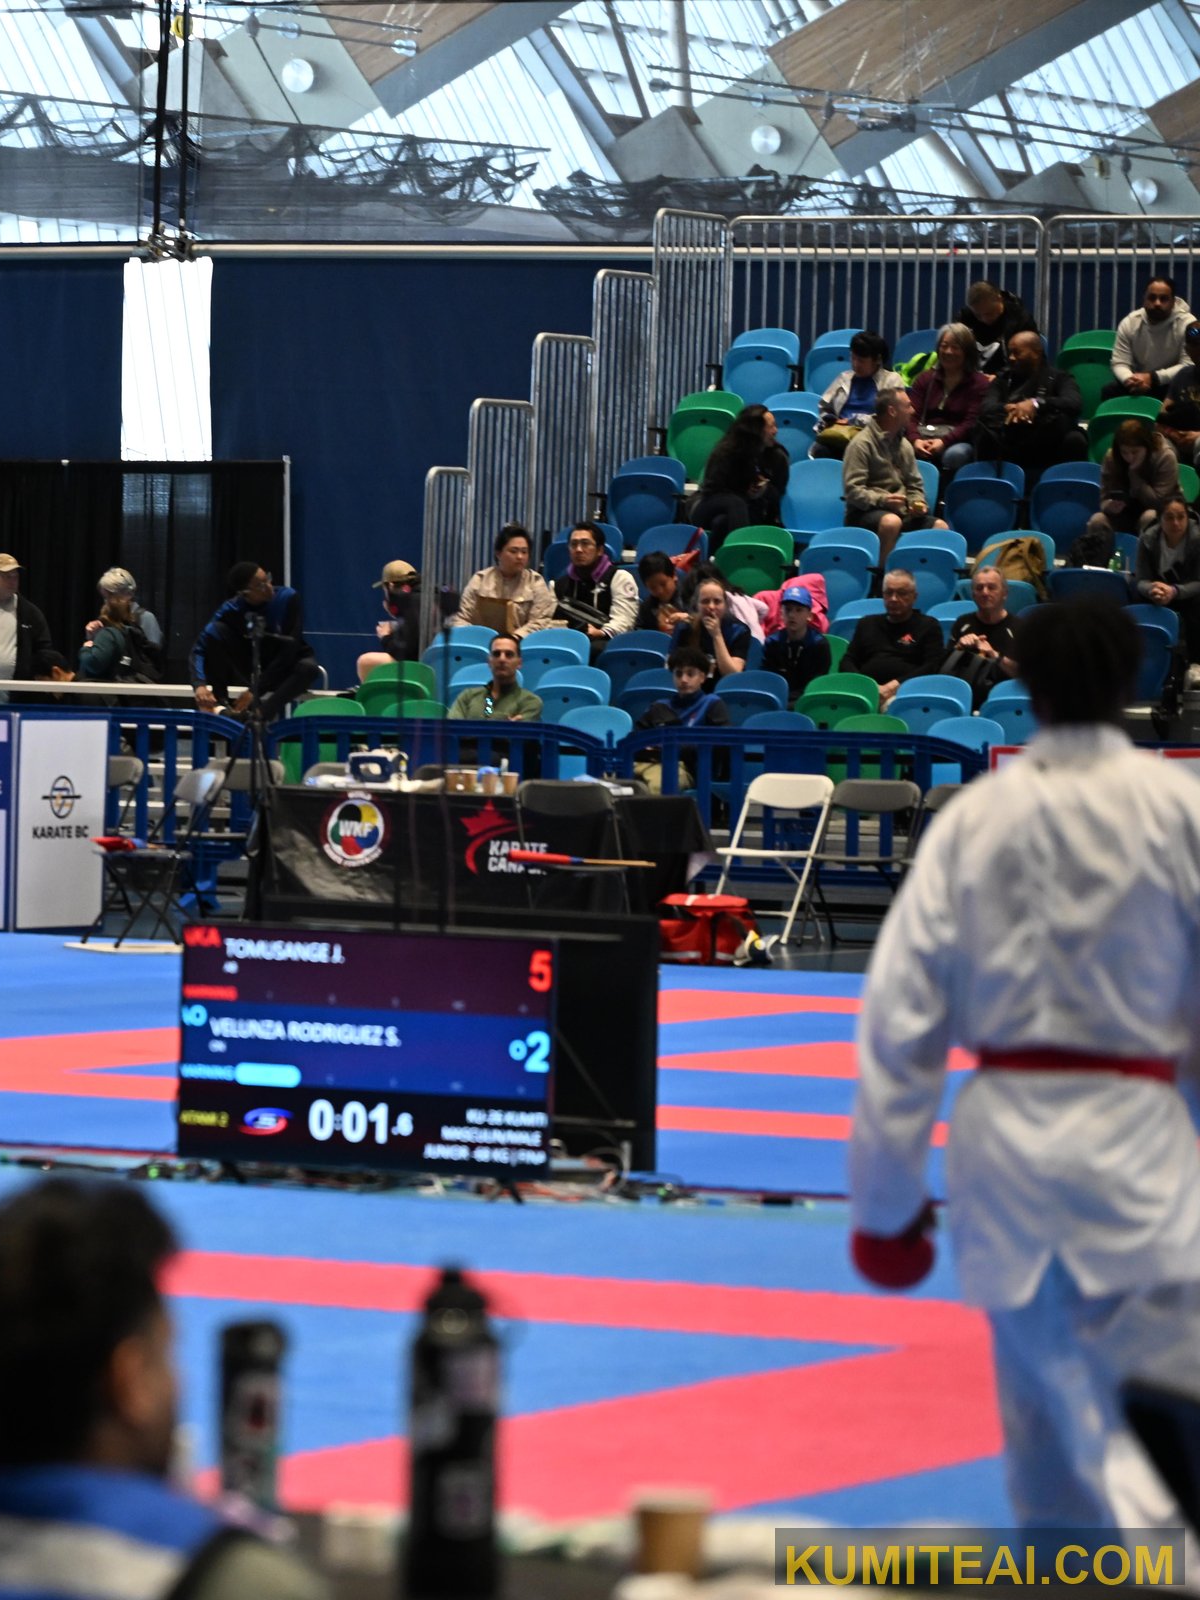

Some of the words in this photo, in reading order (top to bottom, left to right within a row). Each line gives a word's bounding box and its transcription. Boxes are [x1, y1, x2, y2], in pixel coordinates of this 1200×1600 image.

[32, 826, 73, 839] KARATE
[75, 825, 90, 838] BC
[338, 819, 373, 838] WKF
[488, 857, 547, 875] CAN
[224, 937, 330, 963] TOMUSANGE
[528, 949, 553, 993] 5
[287, 1021, 384, 1047] RODRIGUEZ
